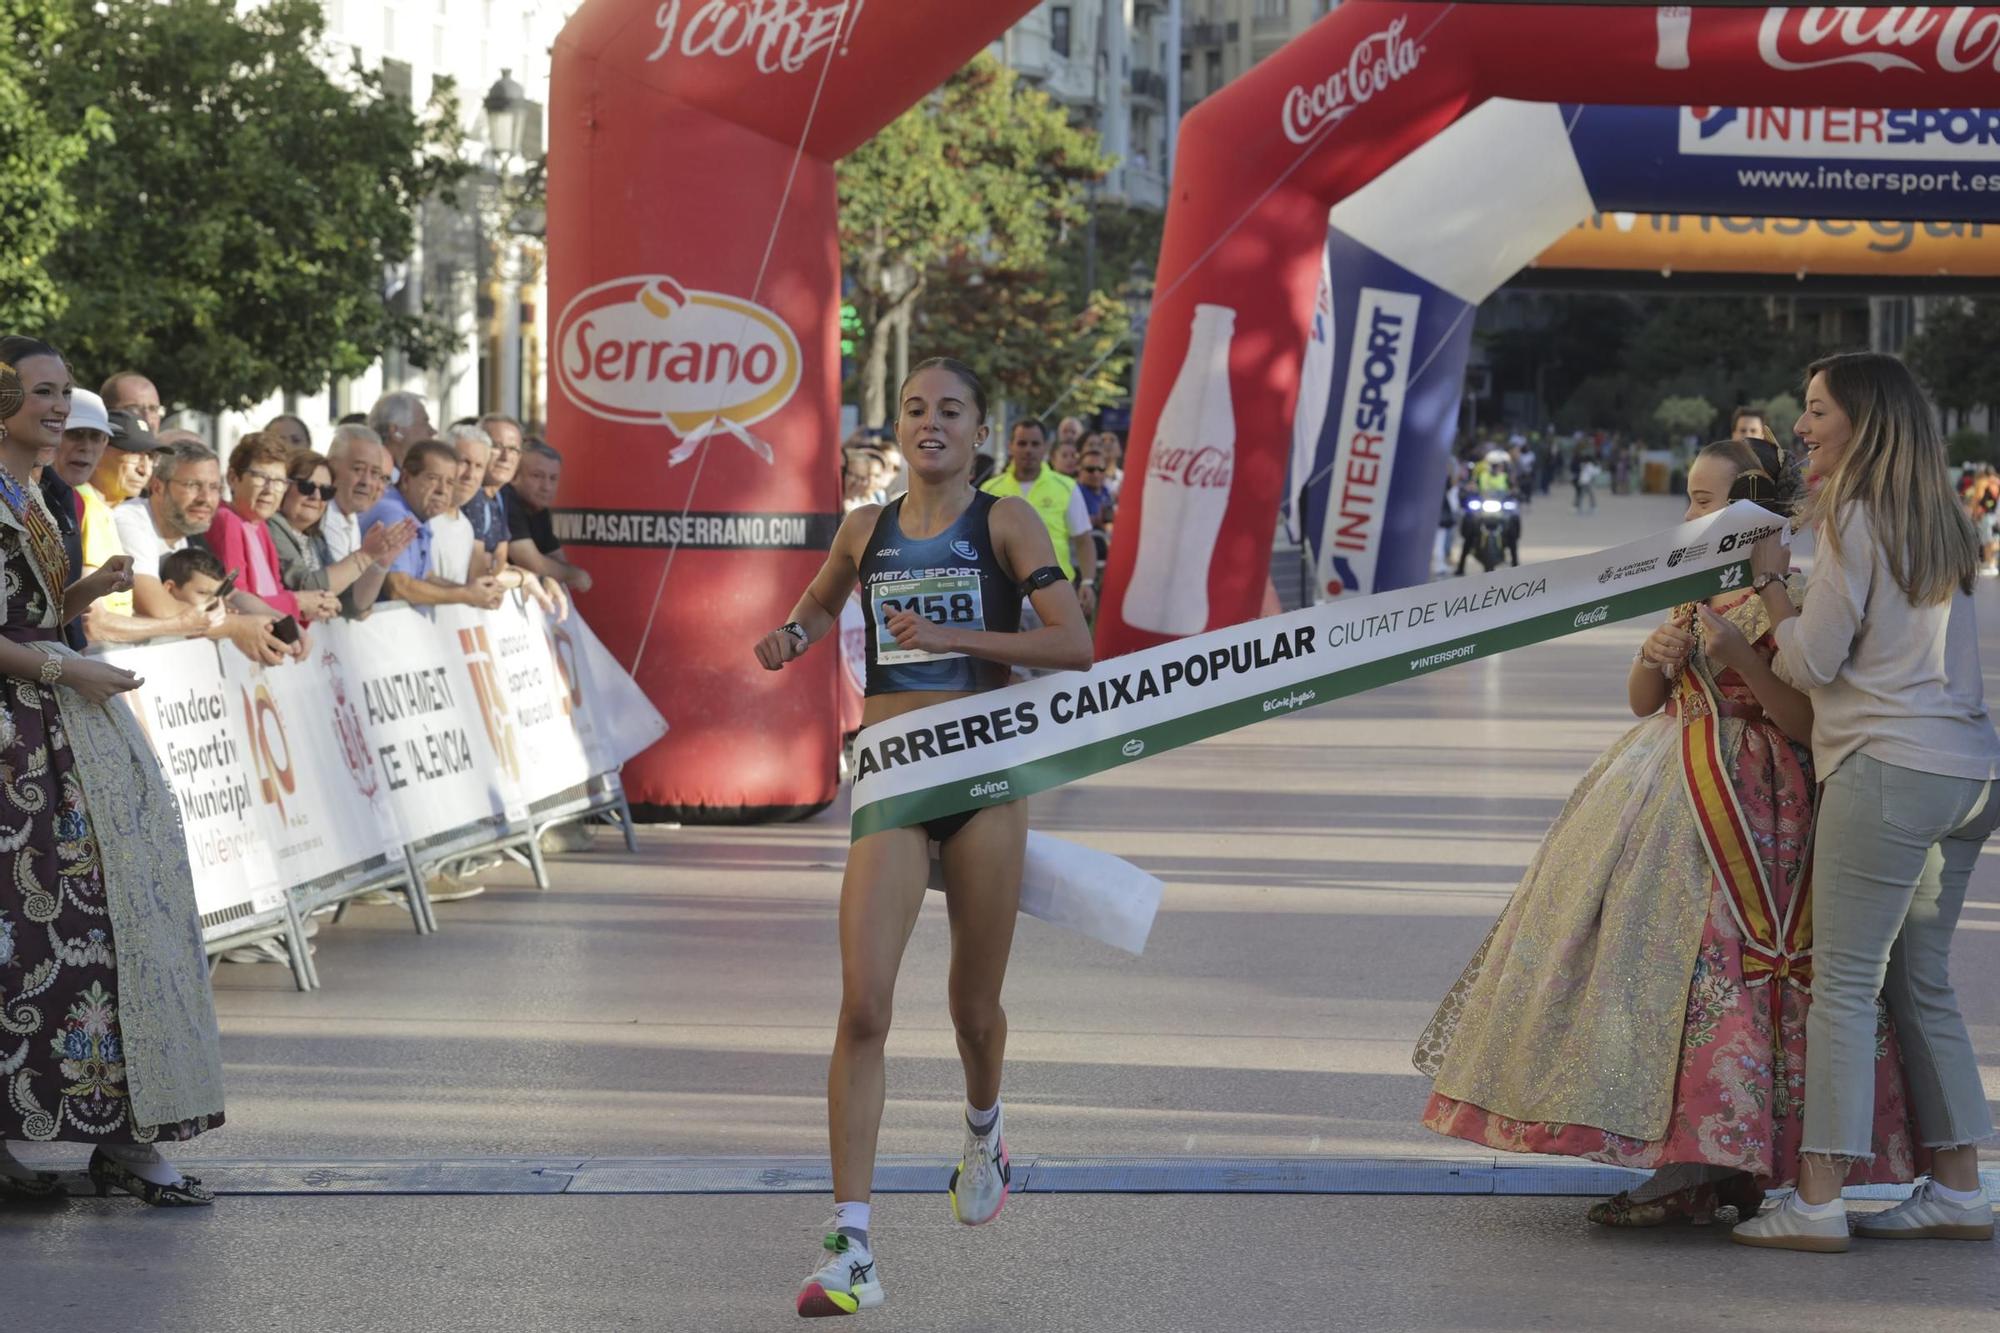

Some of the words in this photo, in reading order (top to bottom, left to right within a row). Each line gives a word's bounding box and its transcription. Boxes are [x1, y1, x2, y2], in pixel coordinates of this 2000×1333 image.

[1281, 13, 1422, 144] Coca-Cola
[1738, 167, 2000, 193] www.intersport.es
[570, 319, 777, 385] Serrano
[1333, 306, 1403, 552] INTERSPORT
[876, 548, 902, 557] 42K
[1740, 525, 1770, 539] caixa
[1327, 610, 1405, 648] CIUTAT
[1408, 605, 1436, 628] DE
[1443, 577, 1547, 619] VALÈNCIA
[1418, 644, 1476, 669] INTERSPORT
[155, 683, 227, 730] Fundaci
[168, 729, 239, 783] Esportiv
[853, 701, 1039, 785] ARRERES
[181, 772, 253, 821] Municipl
[970, 781, 1009, 797] divina
